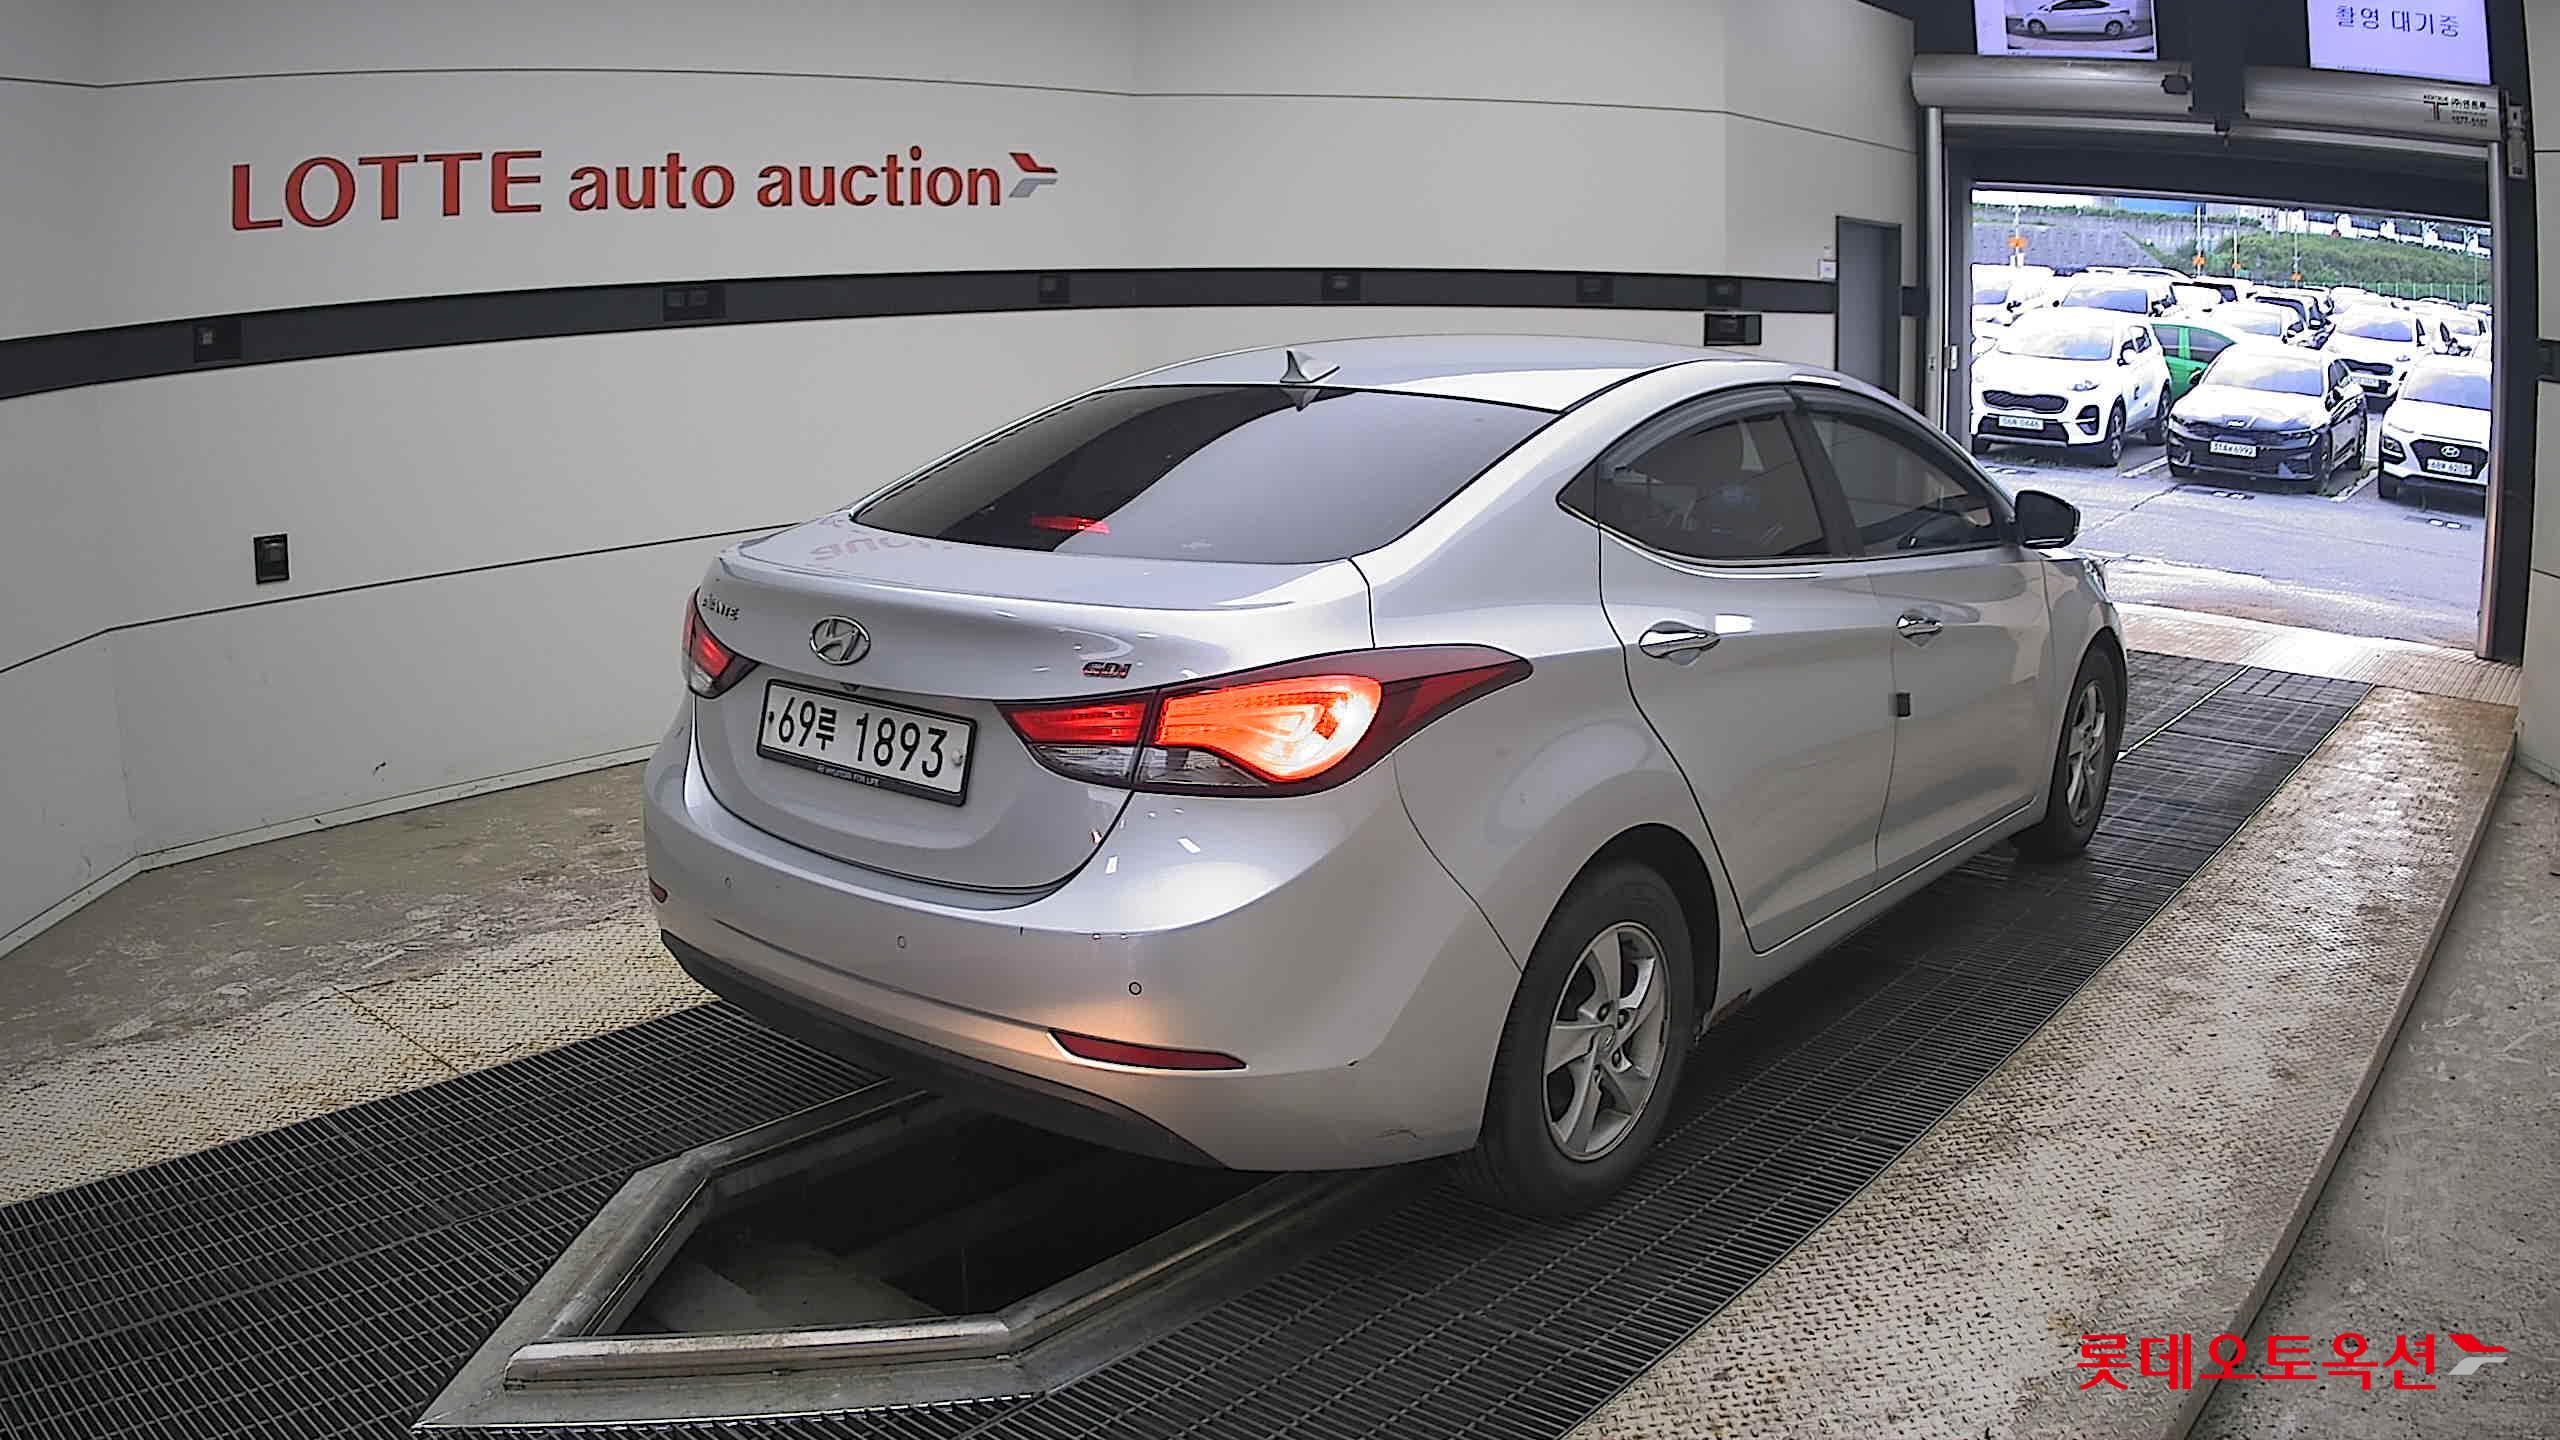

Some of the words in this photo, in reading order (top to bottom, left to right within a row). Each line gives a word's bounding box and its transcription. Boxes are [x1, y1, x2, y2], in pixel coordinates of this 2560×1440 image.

[2335, 4, 2381, 30] 촬영
[2391, 10, 2460, 38] 대기중
[232, 150, 542, 231] LOTTE
[568, 152, 736, 212] auto
[756, 145, 1001, 208] auction
[778, 696, 838, 750] 69루
[855, 712, 949, 779] 1893
